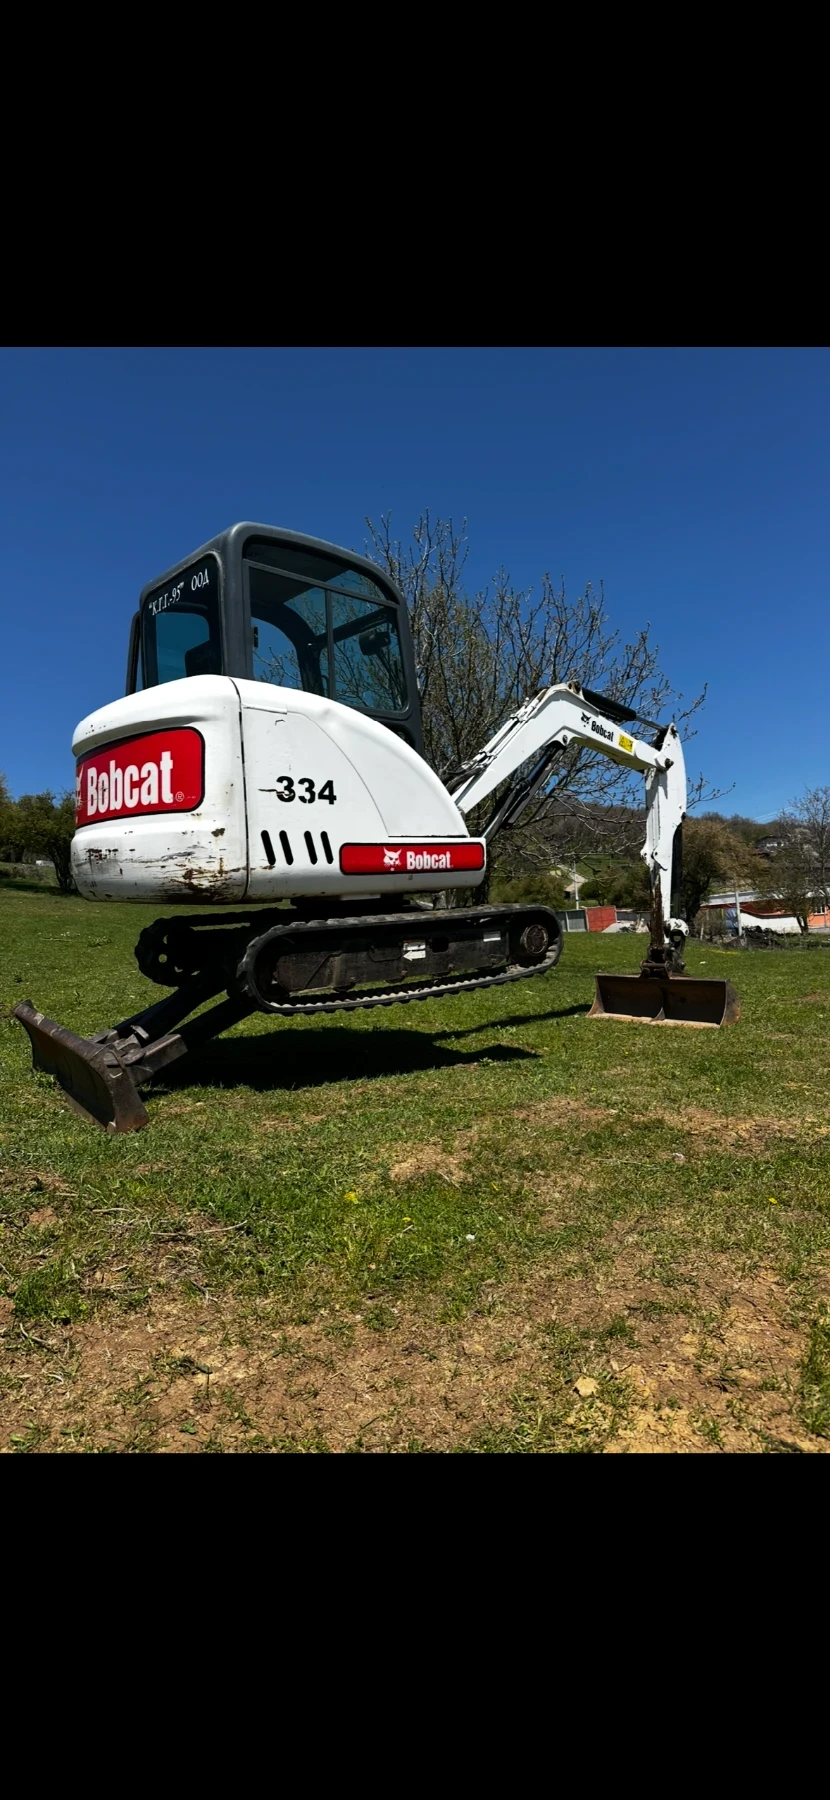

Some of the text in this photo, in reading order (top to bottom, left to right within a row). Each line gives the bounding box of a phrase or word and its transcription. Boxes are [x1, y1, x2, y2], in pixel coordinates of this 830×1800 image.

[591, 720, 614, 742] Bobcat
[87, 751, 173, 816] Bobcat
[276, 776, 337, 805] 334
[406, 851, 451, 870] Bobcat
